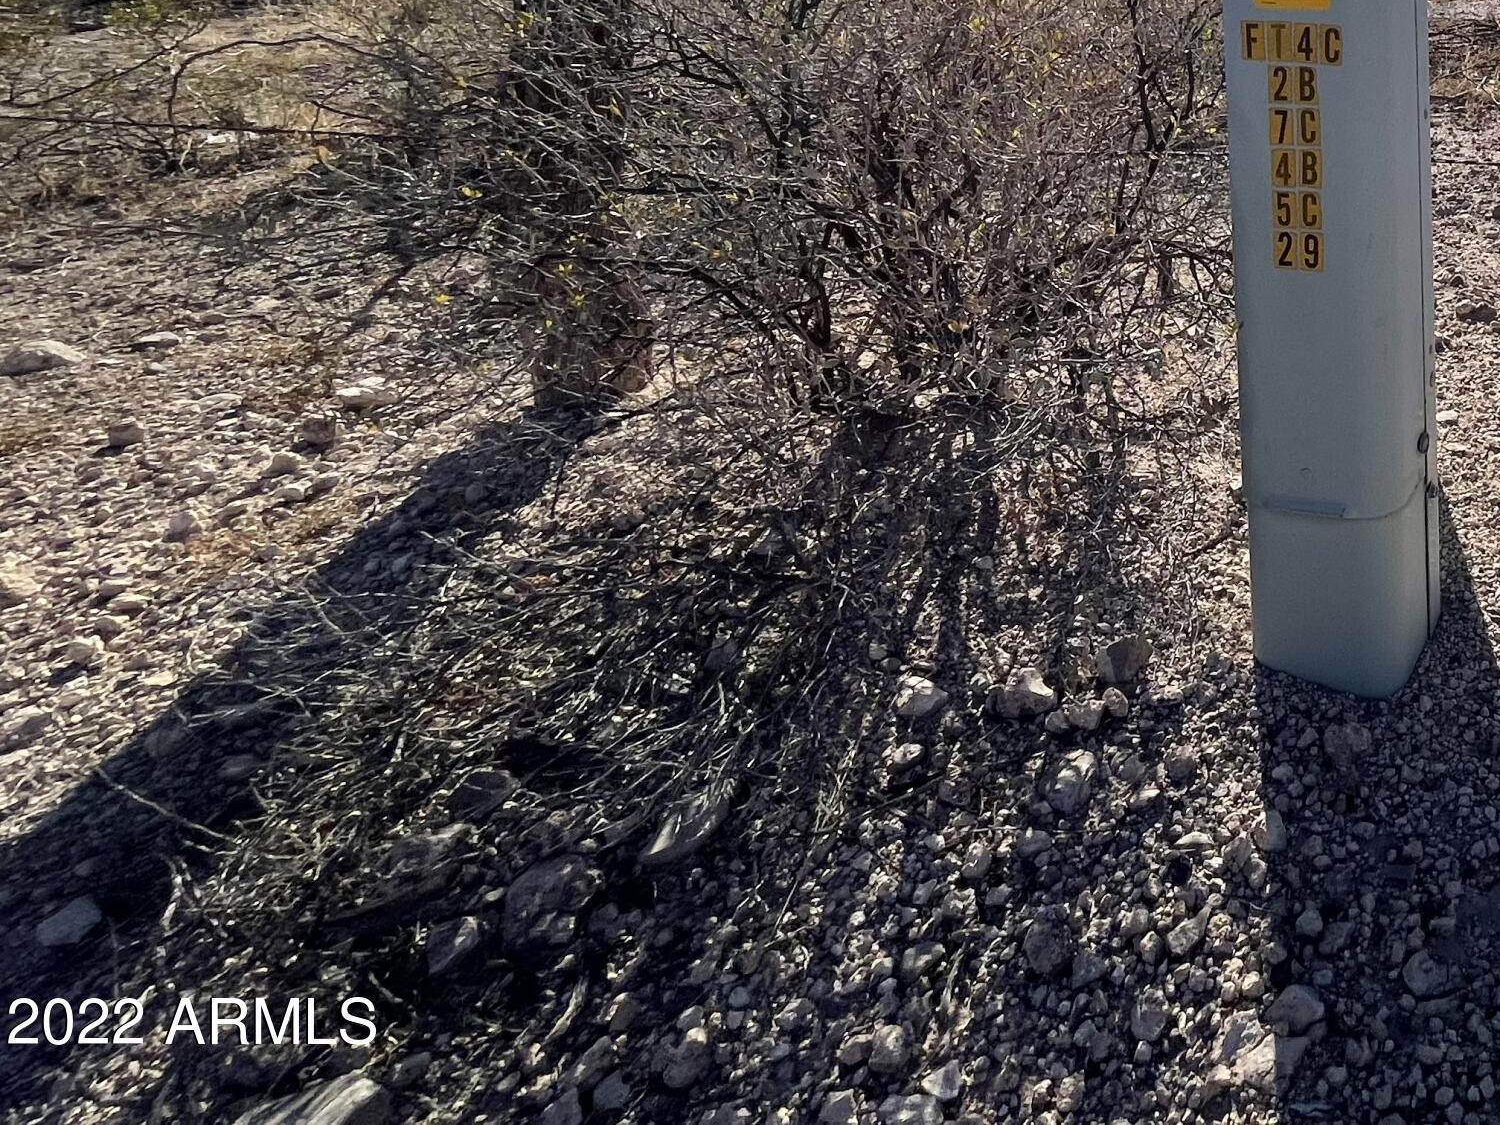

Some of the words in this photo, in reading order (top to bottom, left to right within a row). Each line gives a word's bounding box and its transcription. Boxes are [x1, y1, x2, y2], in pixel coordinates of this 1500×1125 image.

[1273, 66, 1316, 102] 2B
[1274, 109, 1316, 145] 7C
[1275, 151, 1318, 187] 4B
[1276, 193, 1317, 228] 5C
[1277, 231, 1320, 269] 29
